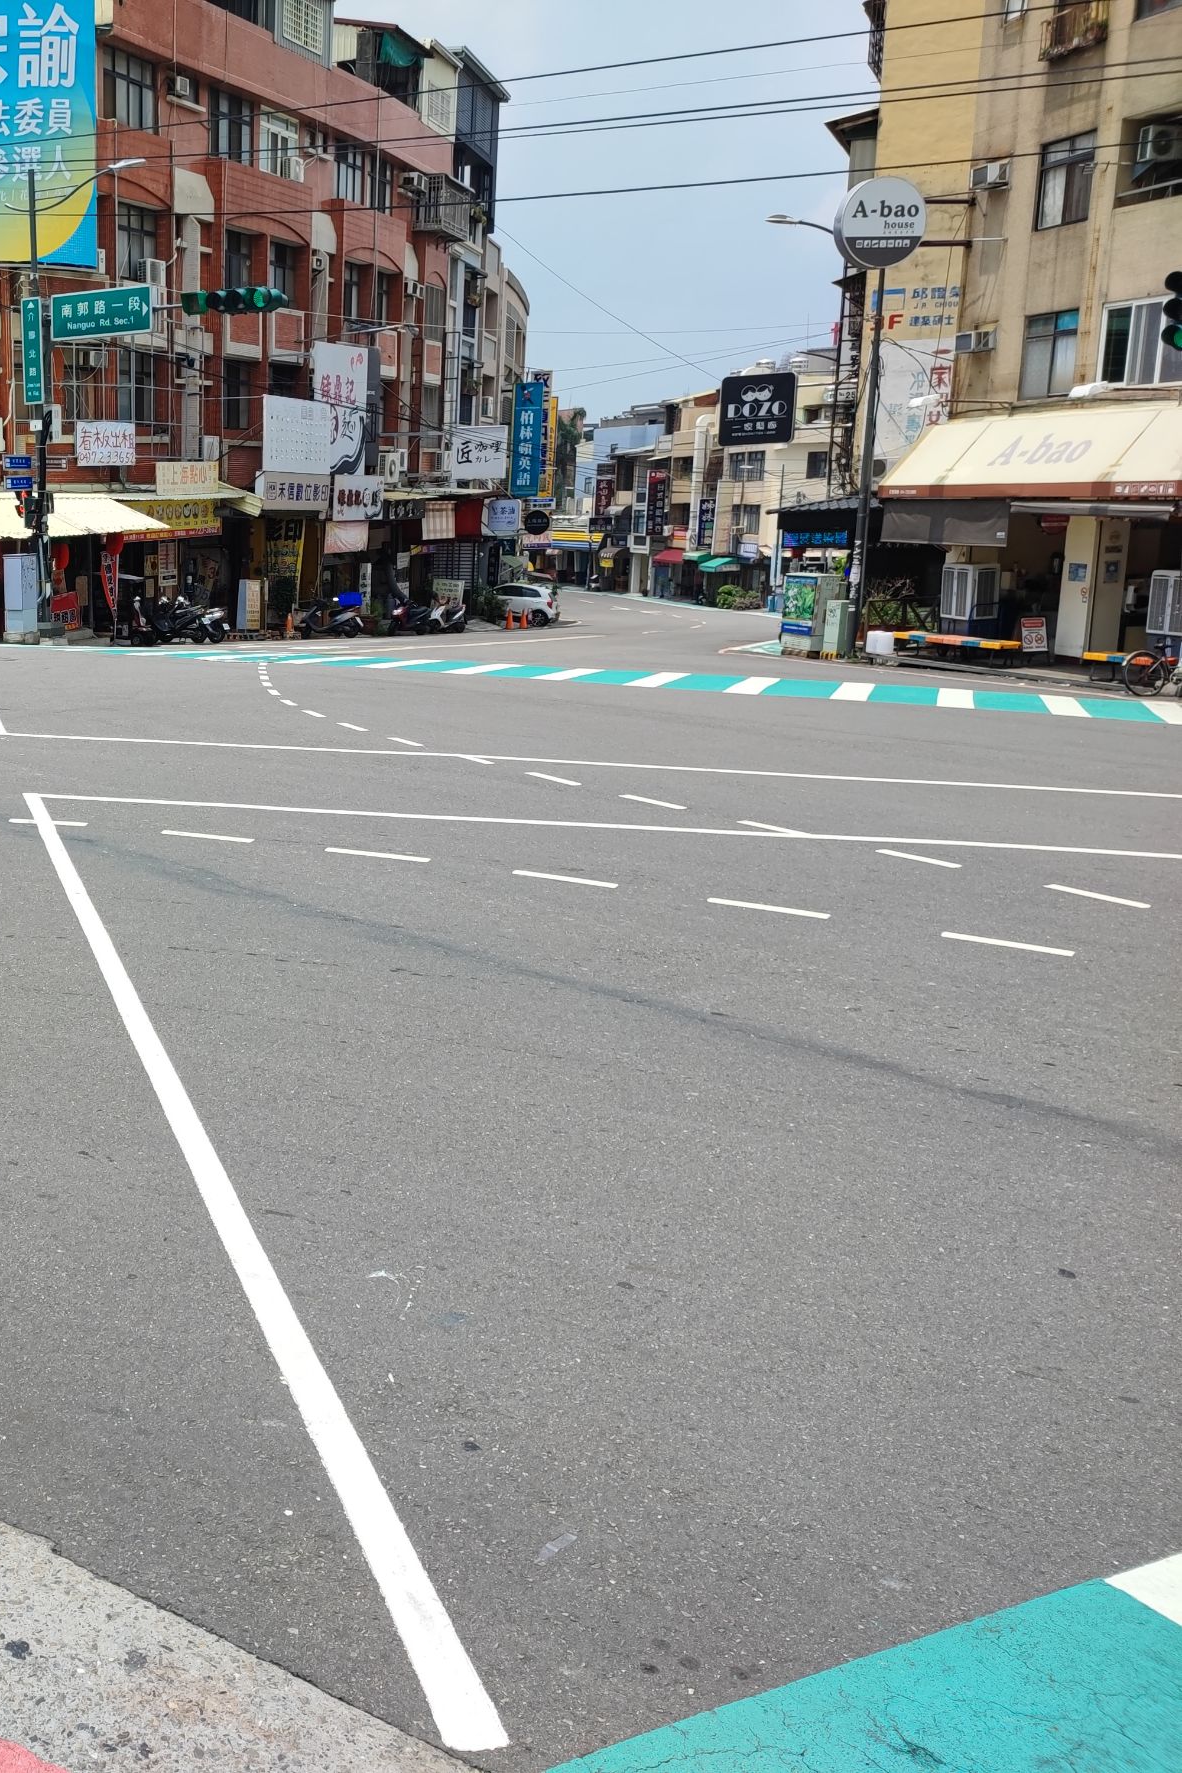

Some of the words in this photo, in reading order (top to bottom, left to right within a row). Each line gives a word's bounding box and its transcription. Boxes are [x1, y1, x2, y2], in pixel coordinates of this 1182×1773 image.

[852, 200, 919, 218] A-bao
[884, 220, 914, 229] house
[61, 296, 141, 318] 南郭路一段
[67, 321, 95, 331] Nanguo
[99, 319, 111, 327] Rd.
[727, 400, 787, 418] DOZO
[457, 441, 473, 464] 匠
[987, 433, 1093, 466] A-bao
[278, 482, 329, 502] 禾信數位影印
